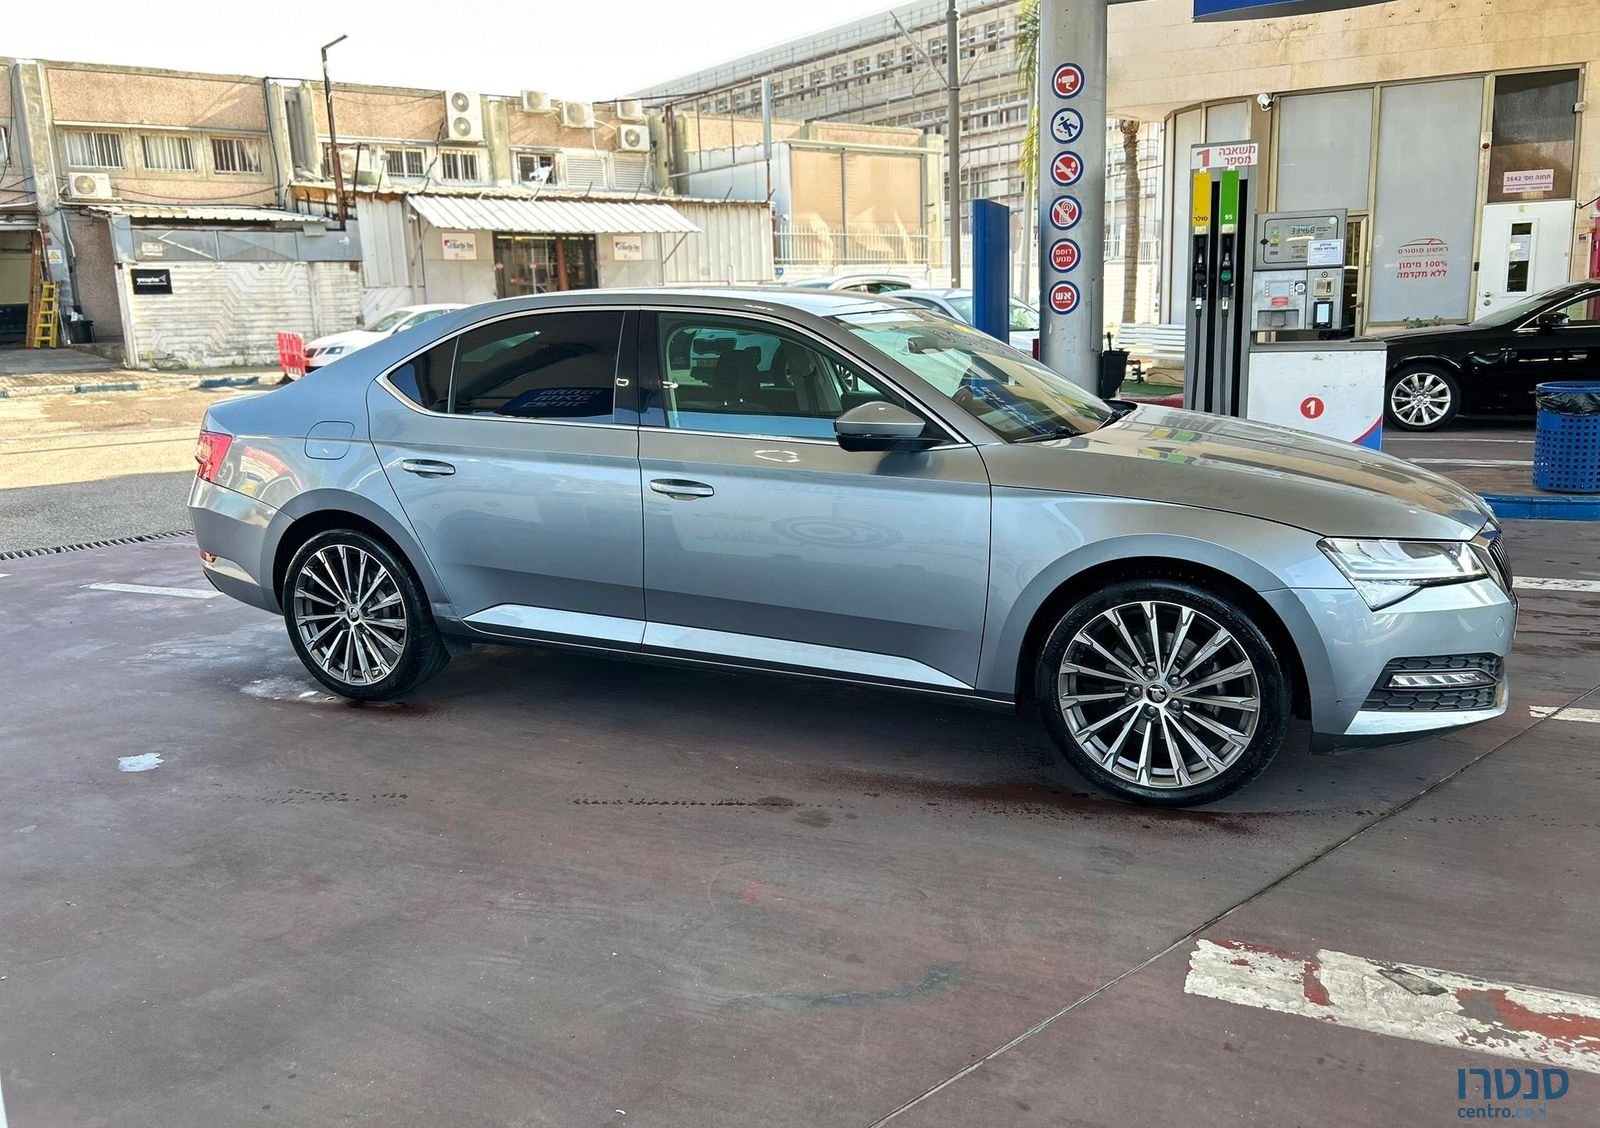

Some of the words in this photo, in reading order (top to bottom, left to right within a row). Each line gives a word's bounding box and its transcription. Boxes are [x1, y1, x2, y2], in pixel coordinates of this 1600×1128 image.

[1219, 145, 1256, 156] משאבה
[1196, 148, 1210, 167] 1
[1225, 155, 1252, 165] מספר
[1399, 261, 1422, 270] מימון
[1425, 260, 1447, 268] 100%
[1397, 271, 1428, 279] מקדמה
[1430, 269, 1447, 277] ללא
[1055, 292, 1072, 300] אש
[1306, 400, 1316, 415] 1
